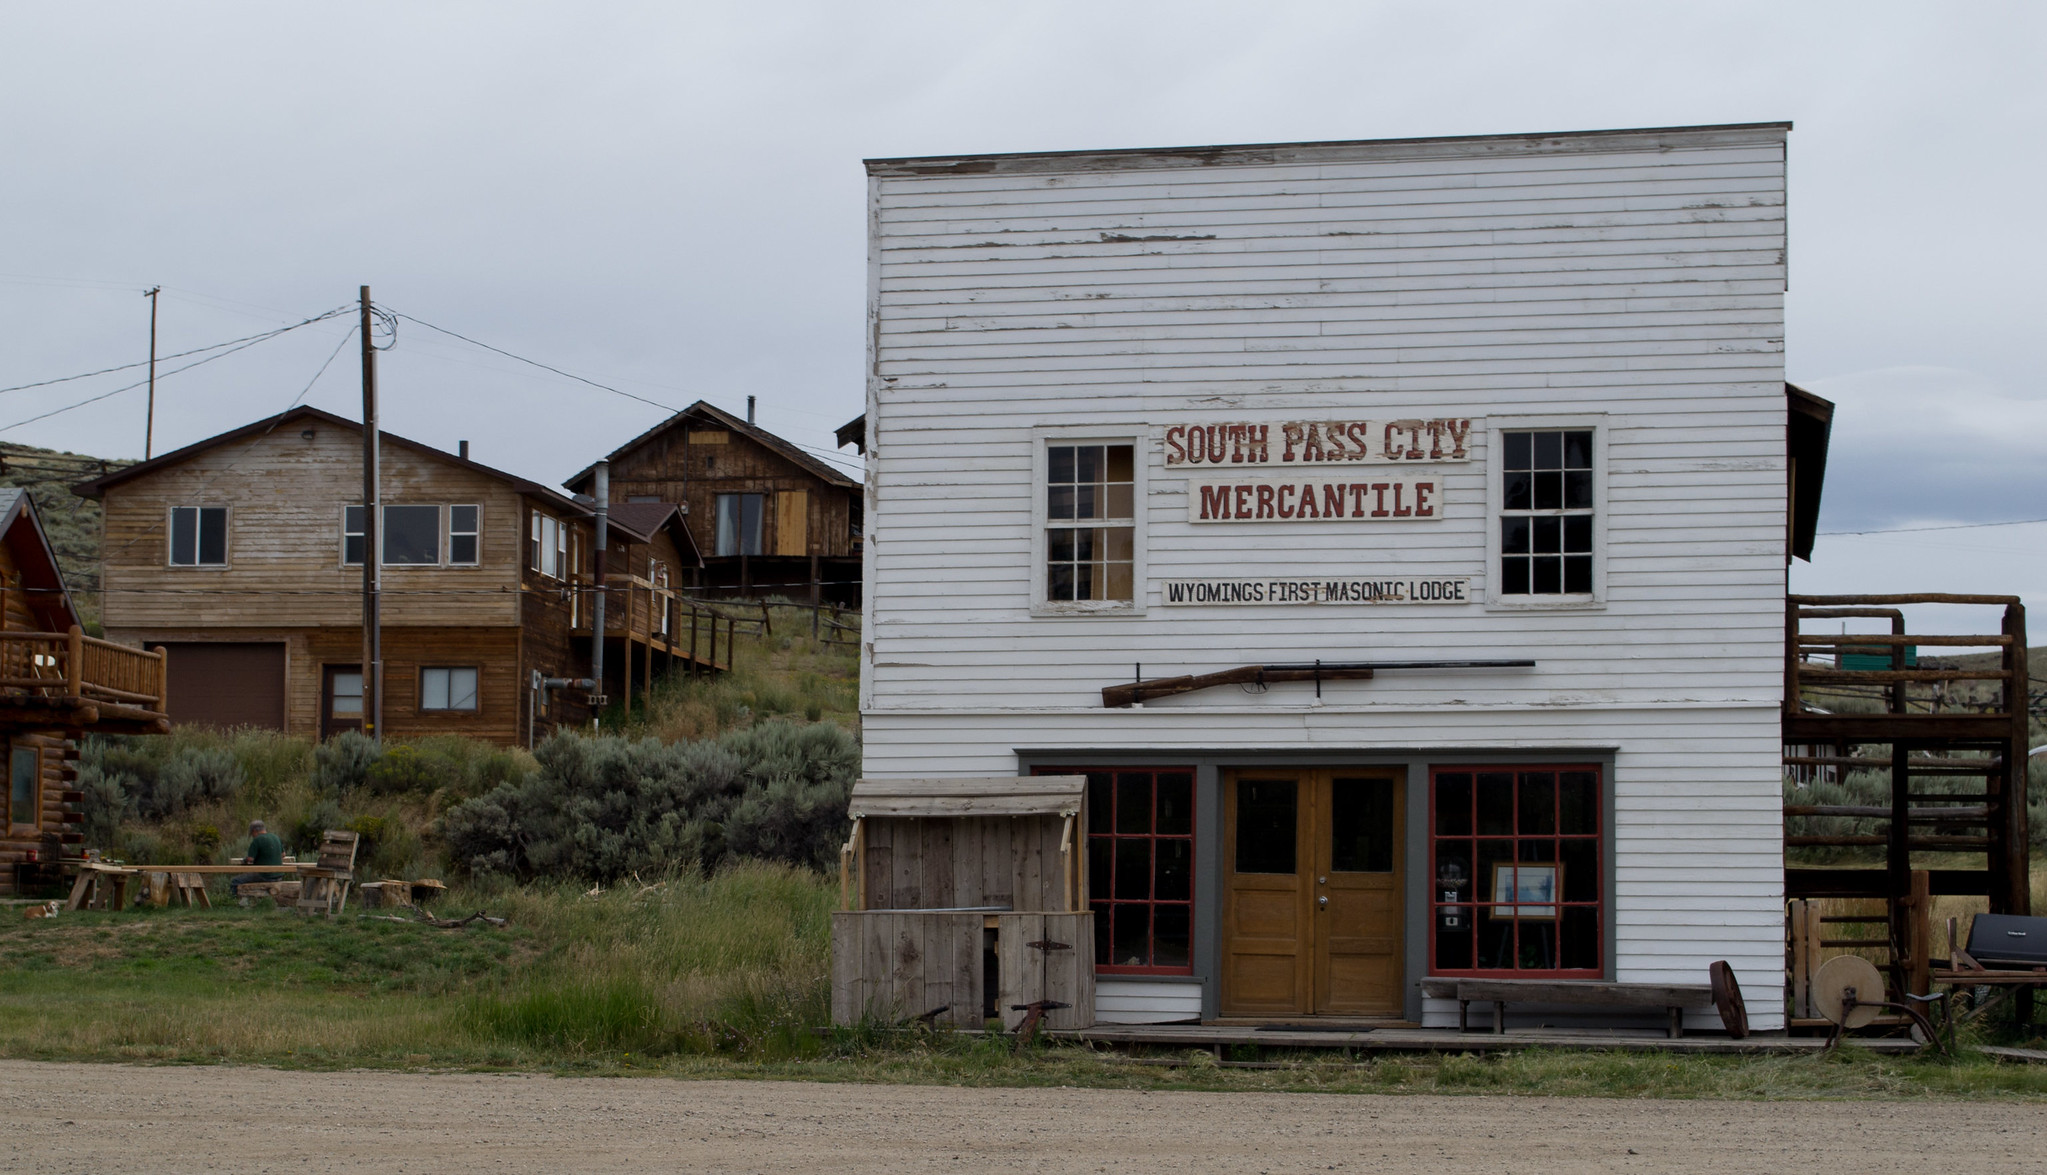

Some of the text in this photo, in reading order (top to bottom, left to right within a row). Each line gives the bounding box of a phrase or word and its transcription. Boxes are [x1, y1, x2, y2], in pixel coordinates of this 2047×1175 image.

[1166, 419, 1470, 464] SOUTH PASS CITY
[1199, 482, 1435, 520] MERCANTILE
[1168, 581, 1465, 602] WYOMINGS FIRST MASONIC LODGE
